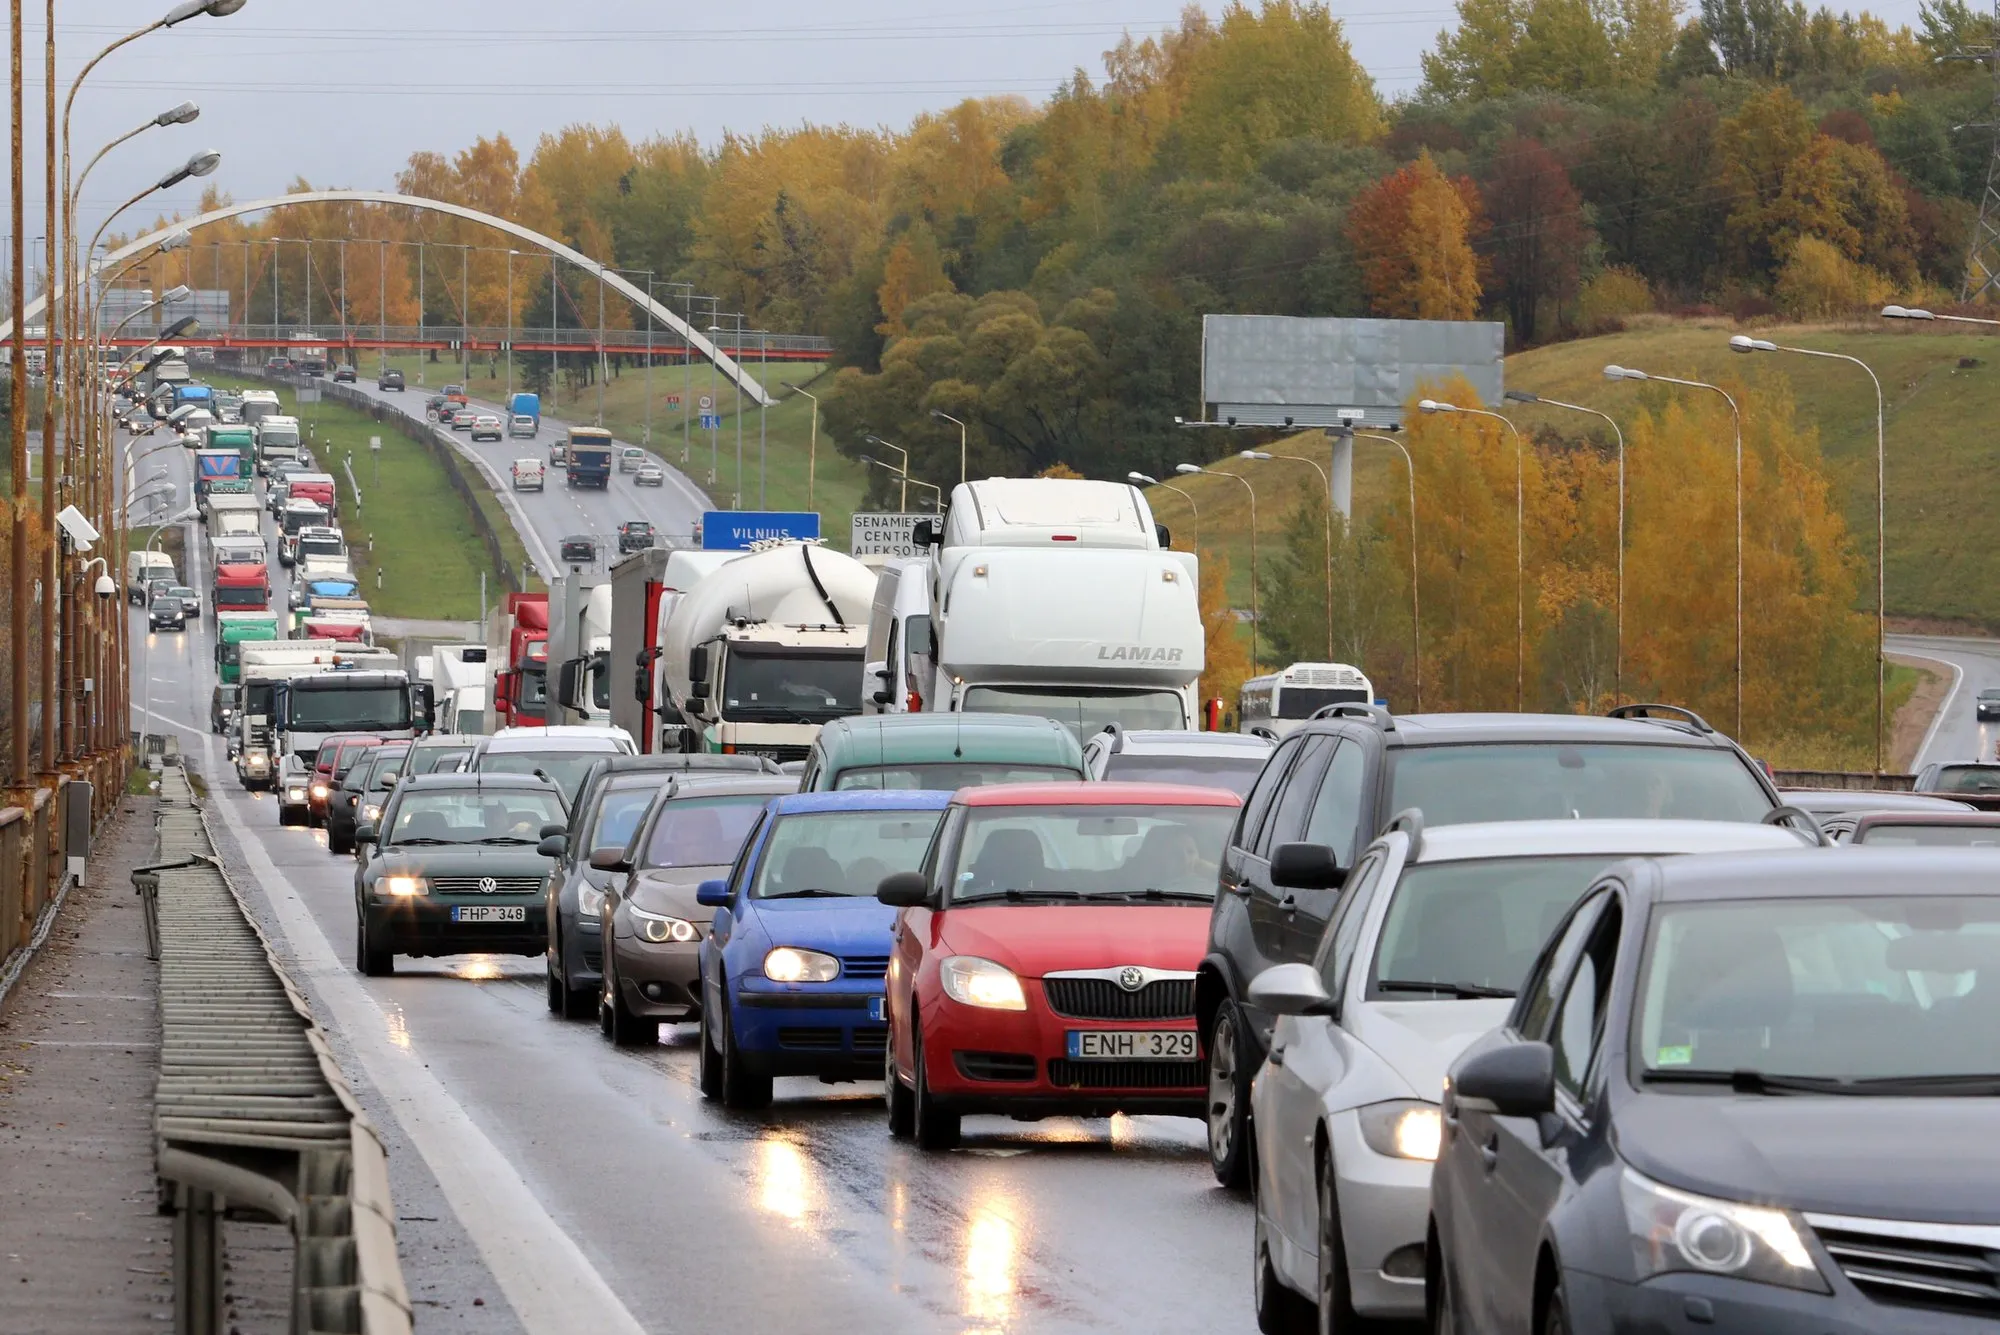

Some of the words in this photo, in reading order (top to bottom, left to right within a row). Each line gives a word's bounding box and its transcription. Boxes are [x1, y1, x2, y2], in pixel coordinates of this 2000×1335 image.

[854, 517, 942, 528] SENAMIESS
[732, 527, 789, 539] VILNIUS
[864, 531, 910, 542] CENTR
[1097, 646, 1184, 661] LAMAR
[460, 908, 490, 920] FHP
[498, 908, 523, 920] 348
[1082, 1034, 1134, 1056] ENH
[1150, 1034, 1193, 1056] 329
